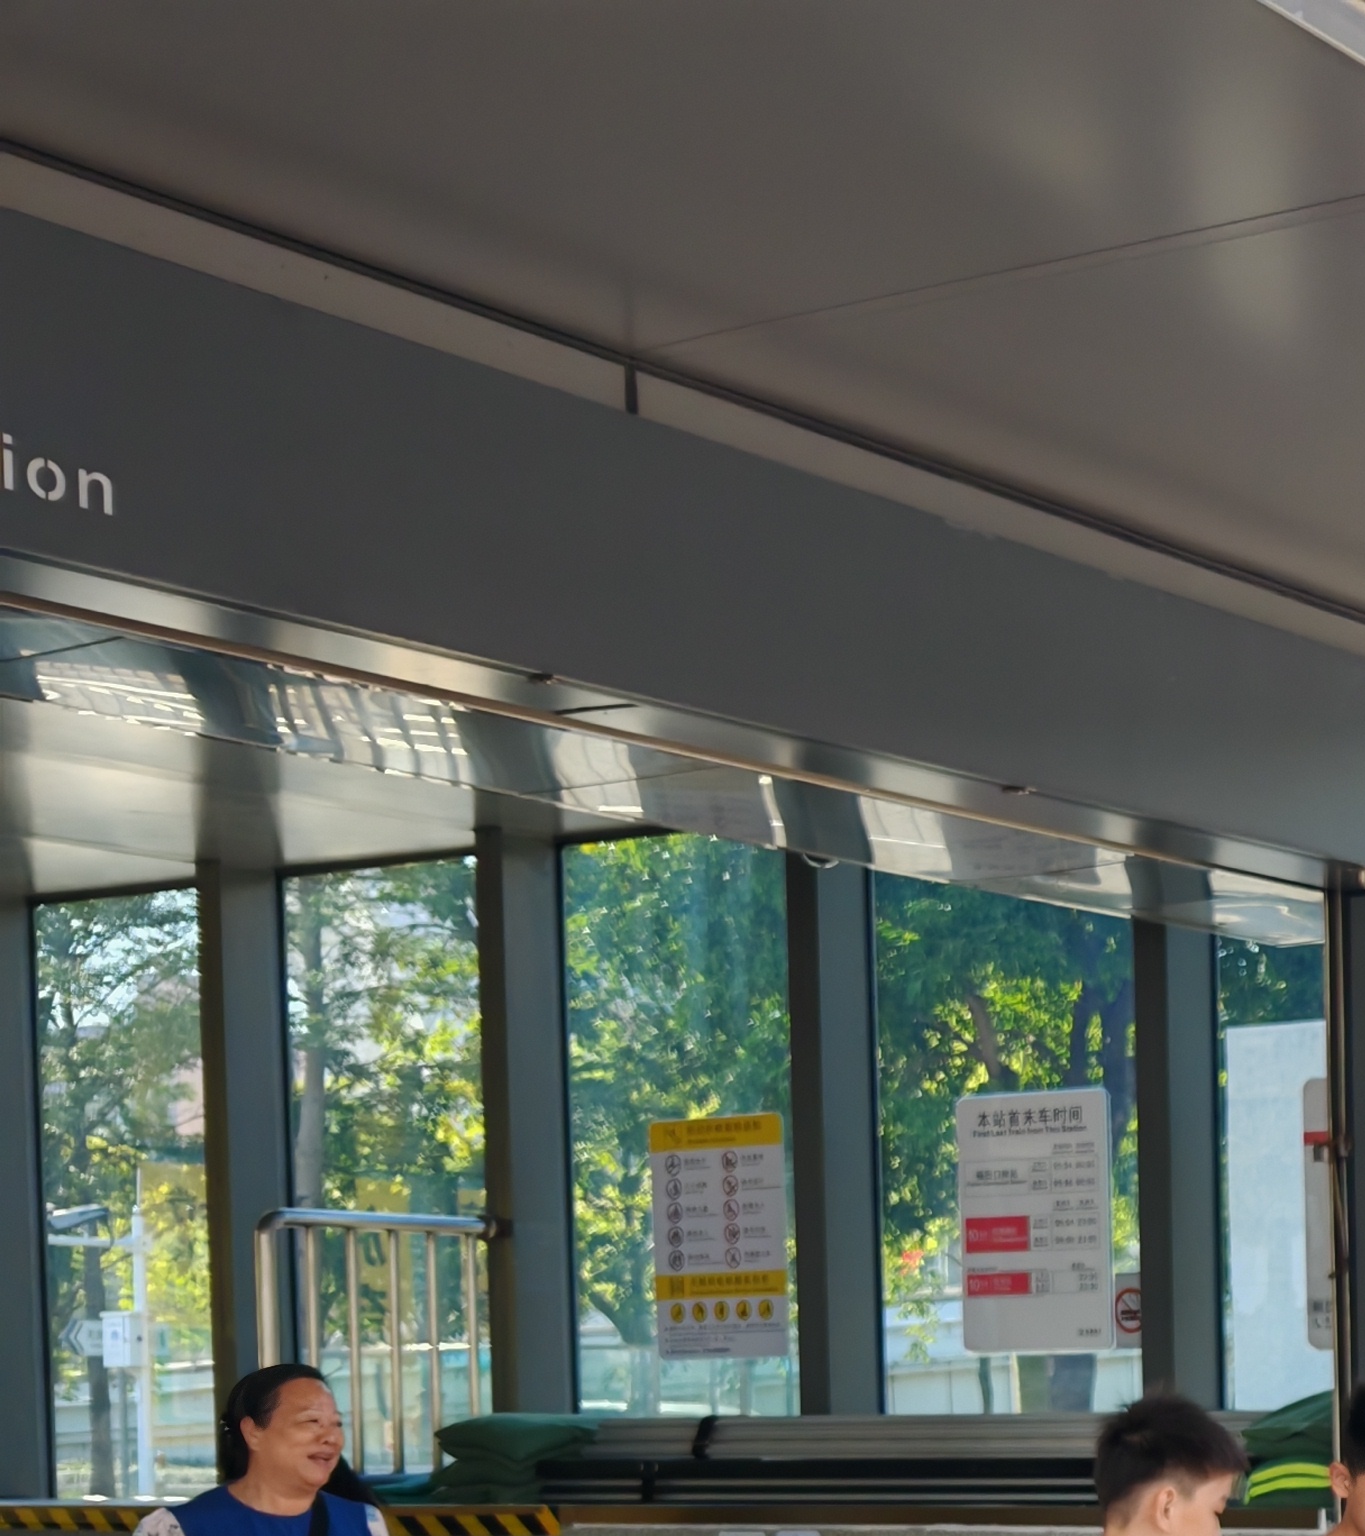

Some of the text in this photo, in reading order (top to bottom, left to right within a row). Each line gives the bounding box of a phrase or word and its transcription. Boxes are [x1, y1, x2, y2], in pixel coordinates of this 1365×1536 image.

[977, 1105, 1084, 1129] 本站首末车时间
